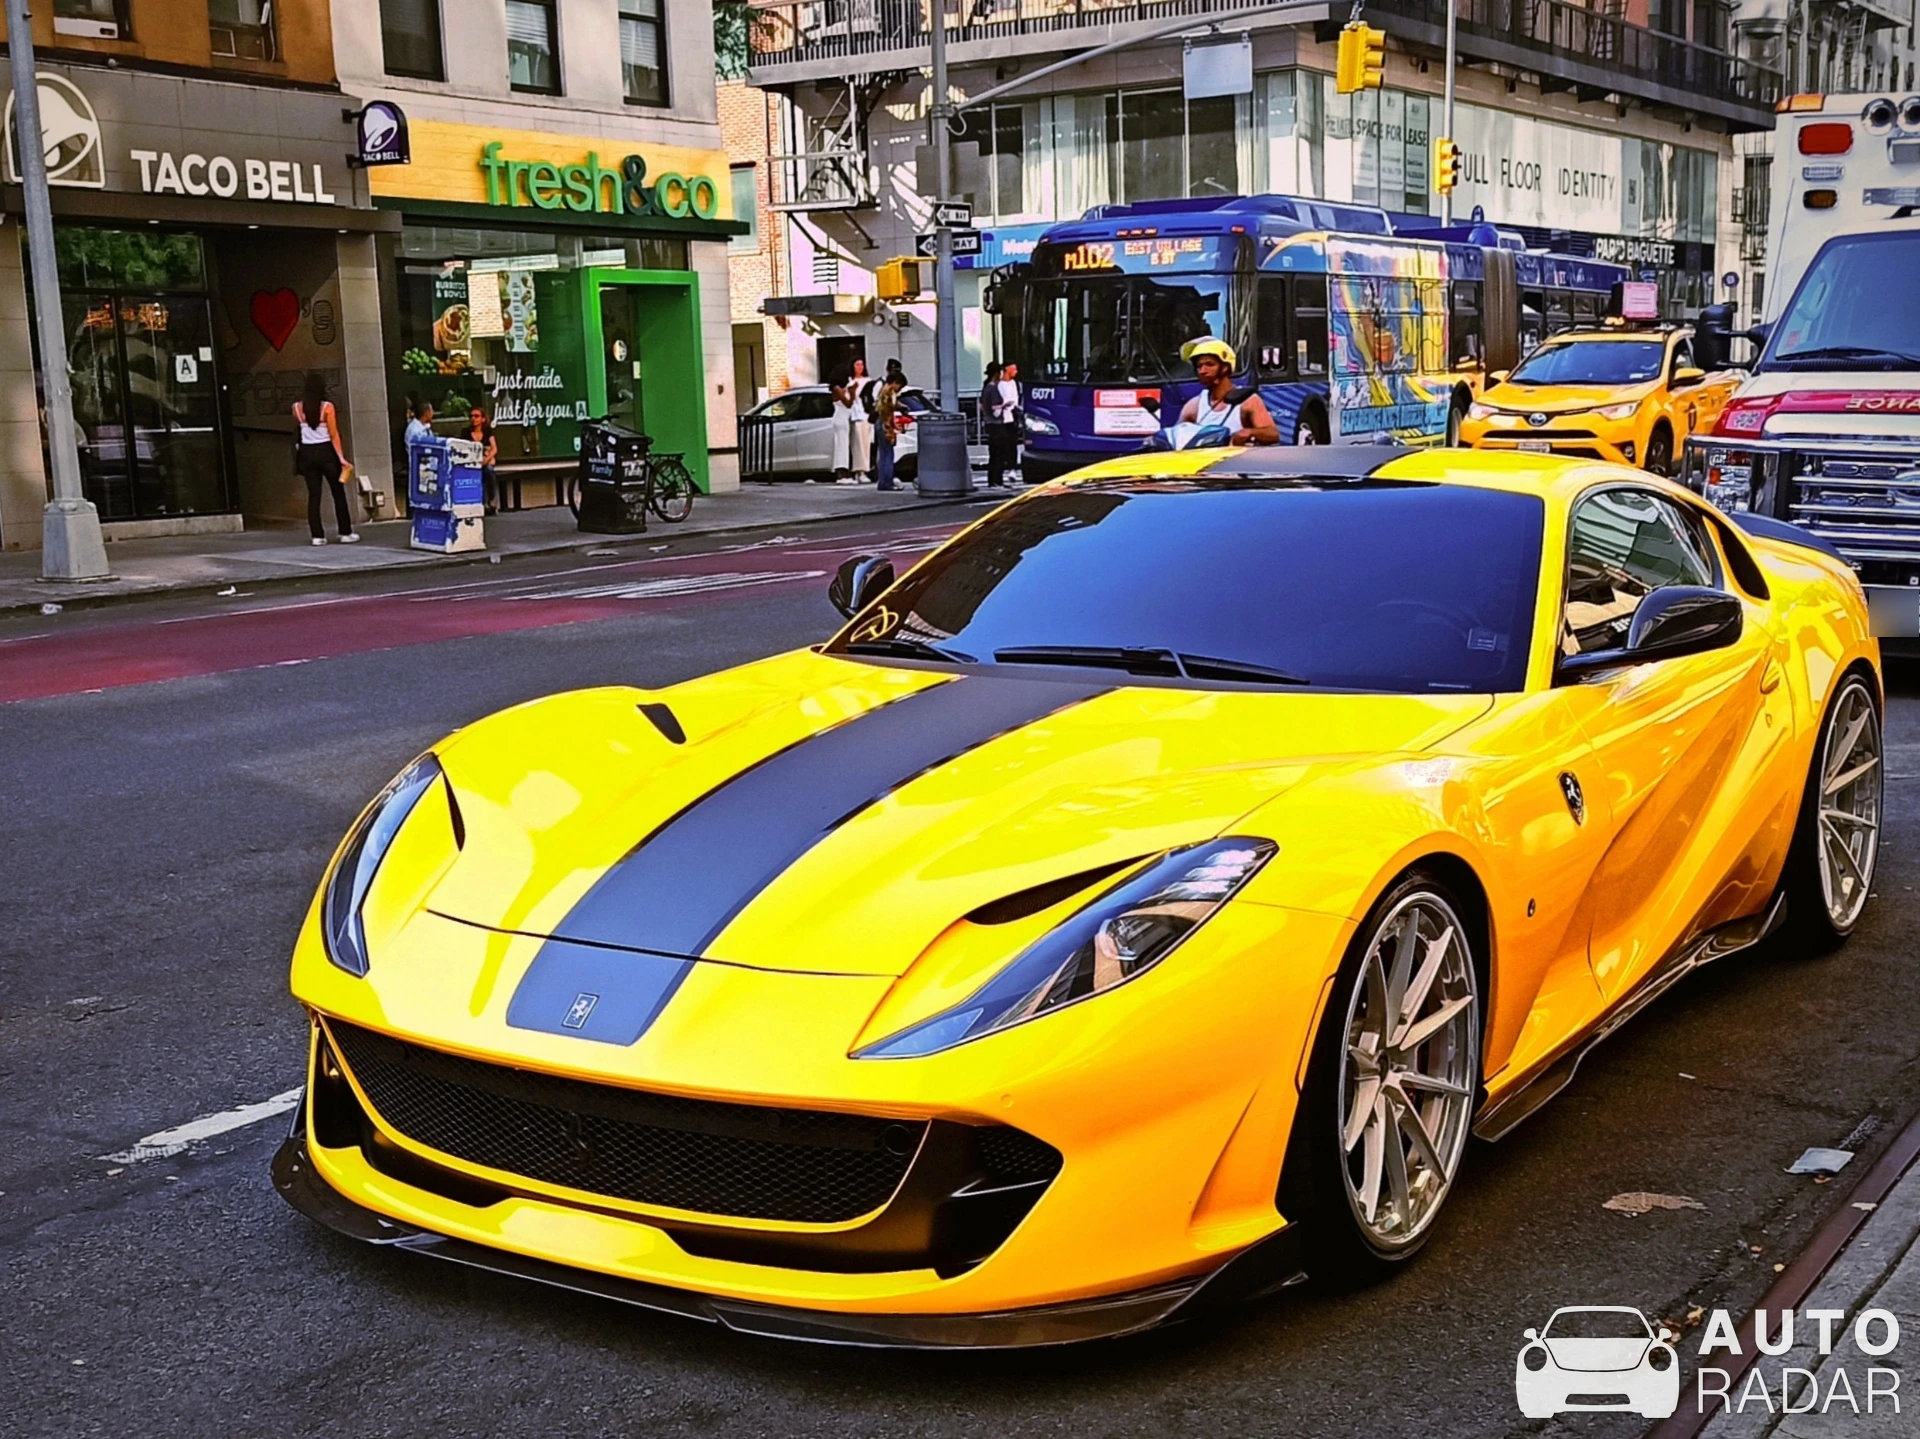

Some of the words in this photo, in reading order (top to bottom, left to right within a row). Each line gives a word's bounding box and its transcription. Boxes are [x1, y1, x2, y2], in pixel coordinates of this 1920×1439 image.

[1356, 118, 1383, 139] SPACE
[1385, 124, 1402, 142] FOR
[1405, 128, 1427, 147] LEASE
[362, 152, 381, 161] TACO
[382, 151, 400, 160] BELL
[130, 150, 238, 197] TACO
[244, 159, 335, 204] BELL
[480, 142, 719, 219] fresh&co
[1501, 158, 1542, 192] FLOOR
[1558, 168, 1616, 200] IDENTITY
[940, 210, 950, 220] ONE
[955, 211, 967, 219] WAY
[953, 239, 973, 248] WAY
[1124, 241, 1153, 255] EAST
[1156, 238, 1203, 254] VILLAGE
[1627, 241, 1675, 264] BAGUETTE
[1064, 243, 1116, 270] M102
[435, 281, 466, 290] BURRITOS
[435, 290, 442, 298] &
[443, 289, 467, 298] BOWLS
[180, 358, 192, 375] A
[492, 369, 523, 397] just
[1031, 387, 1055, 400] 6071
[491, 399, 523, 428] just
[522, 400, 544, 427] for
[545, 404, 574, 426] you.
